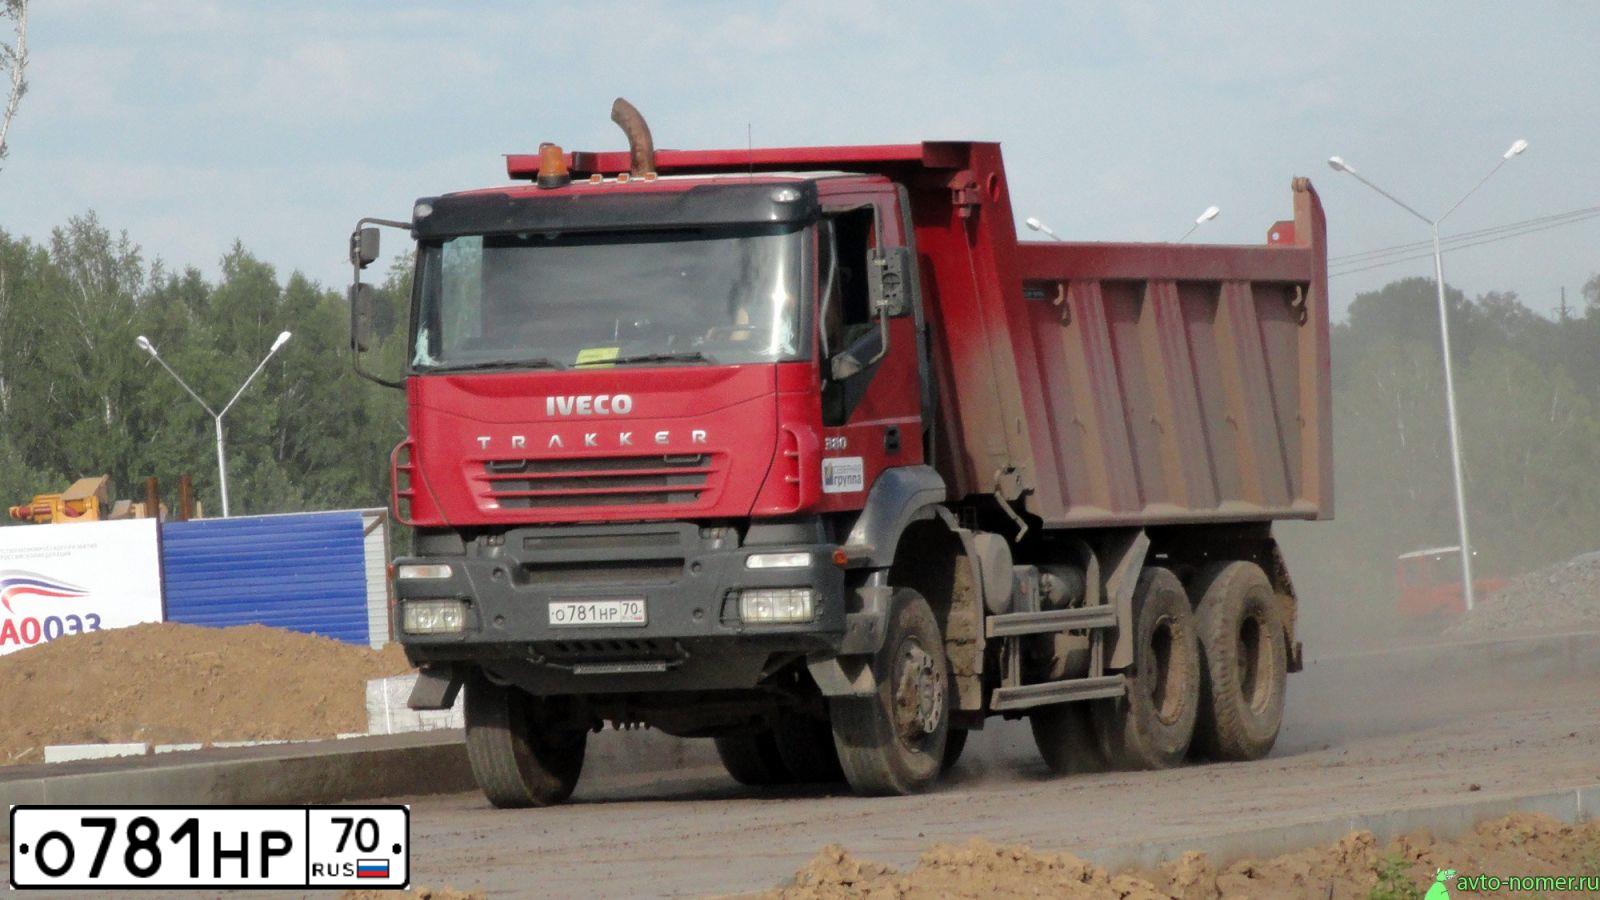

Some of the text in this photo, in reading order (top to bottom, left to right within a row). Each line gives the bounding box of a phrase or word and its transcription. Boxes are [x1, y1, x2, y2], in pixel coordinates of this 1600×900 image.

[546, 394, 633, 416] IVECO
[477, 429, 707, 449] TRAKKER
[623, 603, 638, 615] 70
